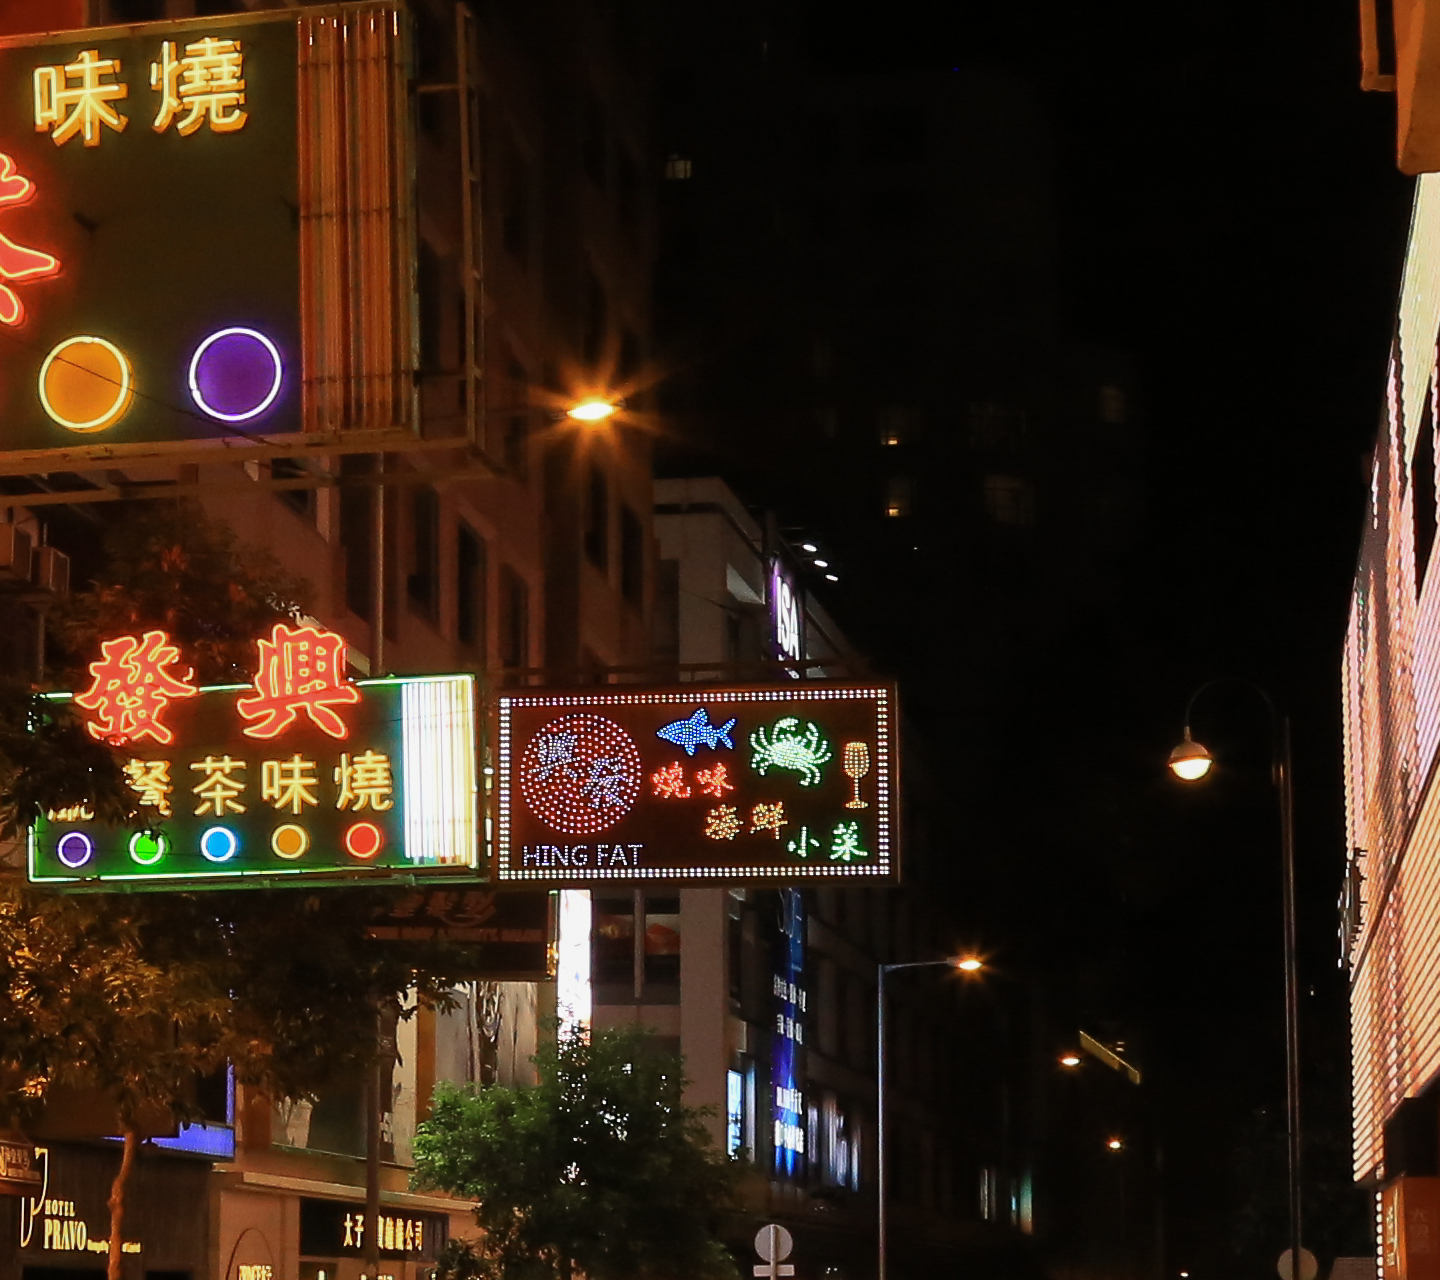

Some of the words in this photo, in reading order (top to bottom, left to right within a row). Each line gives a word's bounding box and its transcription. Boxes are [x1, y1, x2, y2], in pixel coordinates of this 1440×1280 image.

[776, 575, 801, 662] ISA
[522, 844, 588, 867] HING
[596, 843, 644, 866] FAT
[44, 1199, 76, 1217] HOTEL
[43, 1218, 88, 1251] PRAVO
